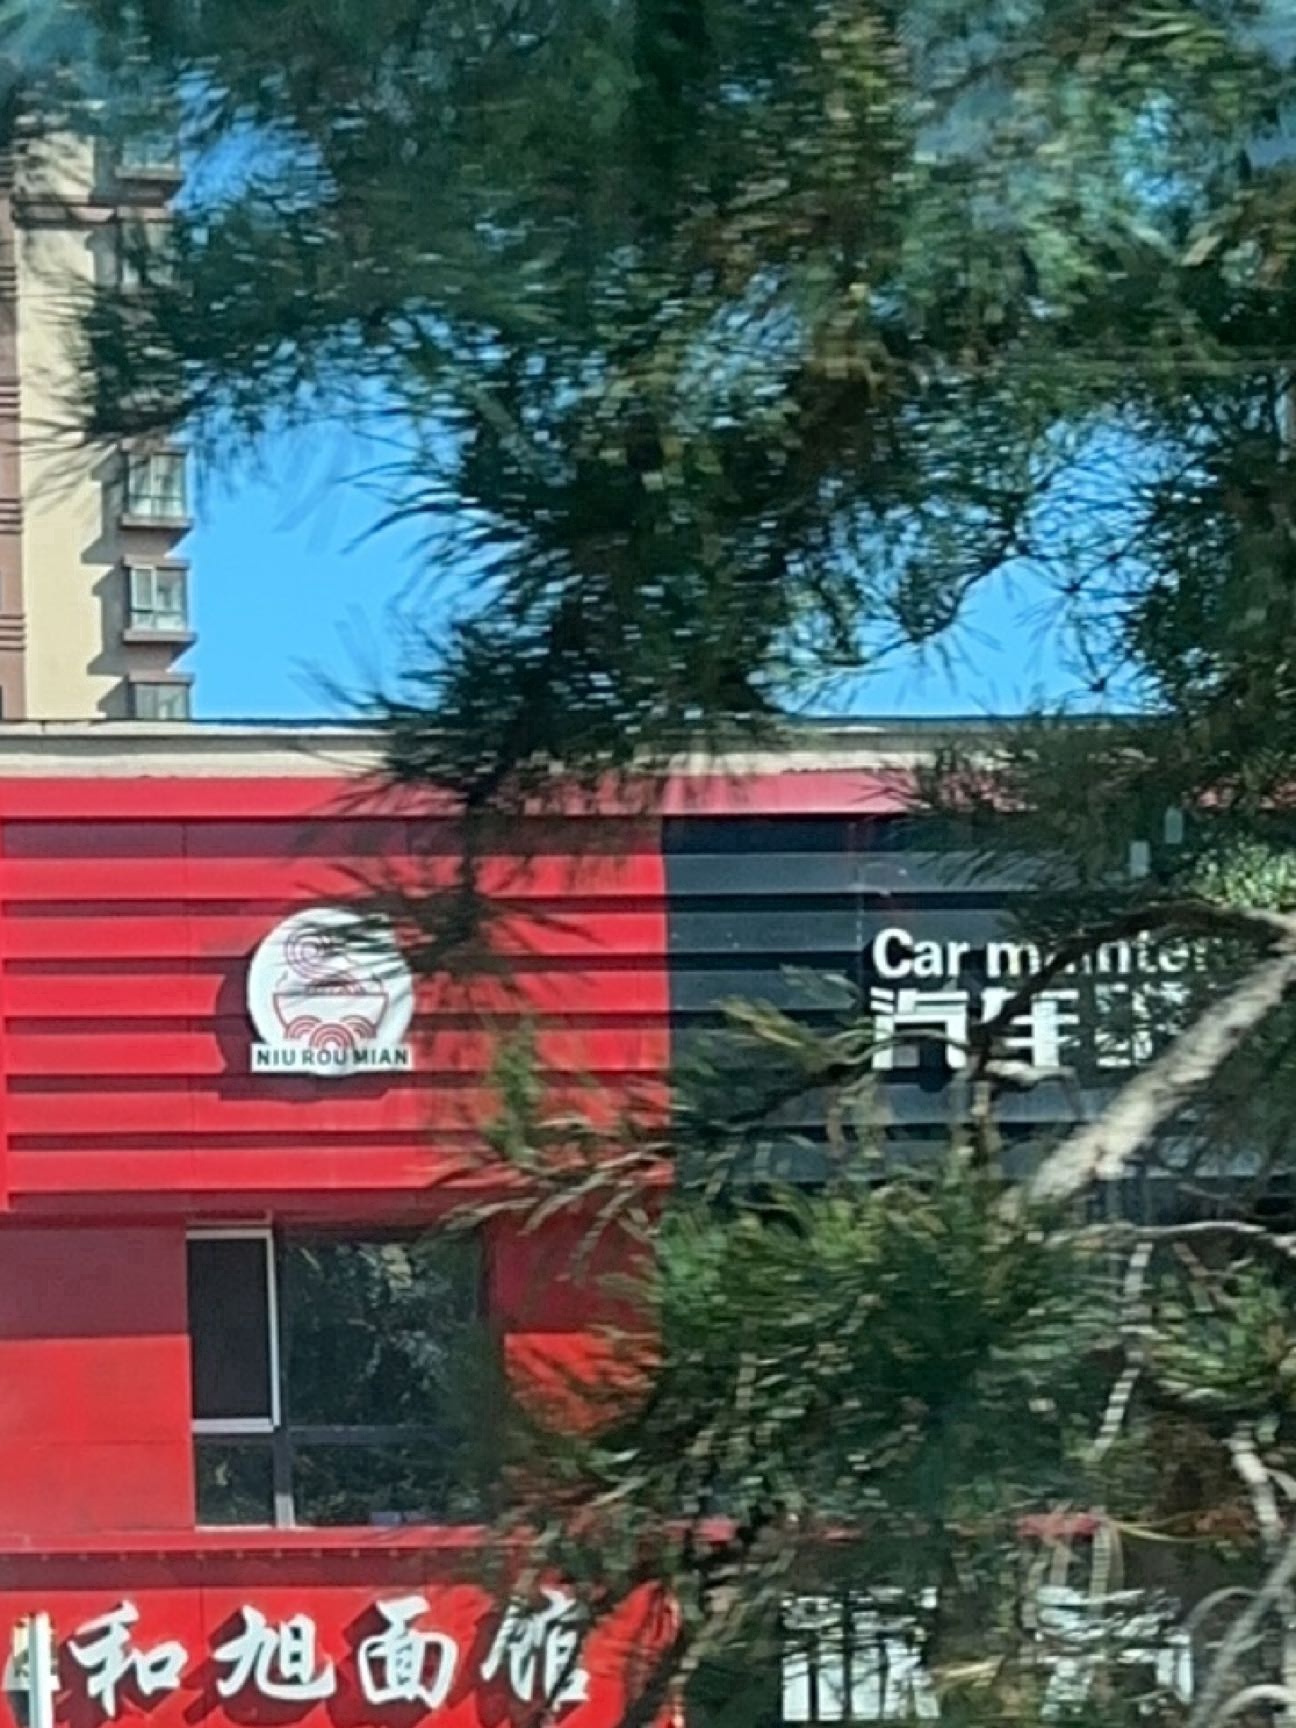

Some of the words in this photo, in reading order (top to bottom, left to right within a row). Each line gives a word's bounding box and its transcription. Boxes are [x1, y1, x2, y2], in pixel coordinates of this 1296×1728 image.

[872, 926, 972, 980] Car
[256, 1048, 297, 1066] NIU
[301, 1048, 349, 1066] ROU
[353, 1048, 408, 1066] MIAN
[66, 1584, 592, 1718] 和旭面馆
